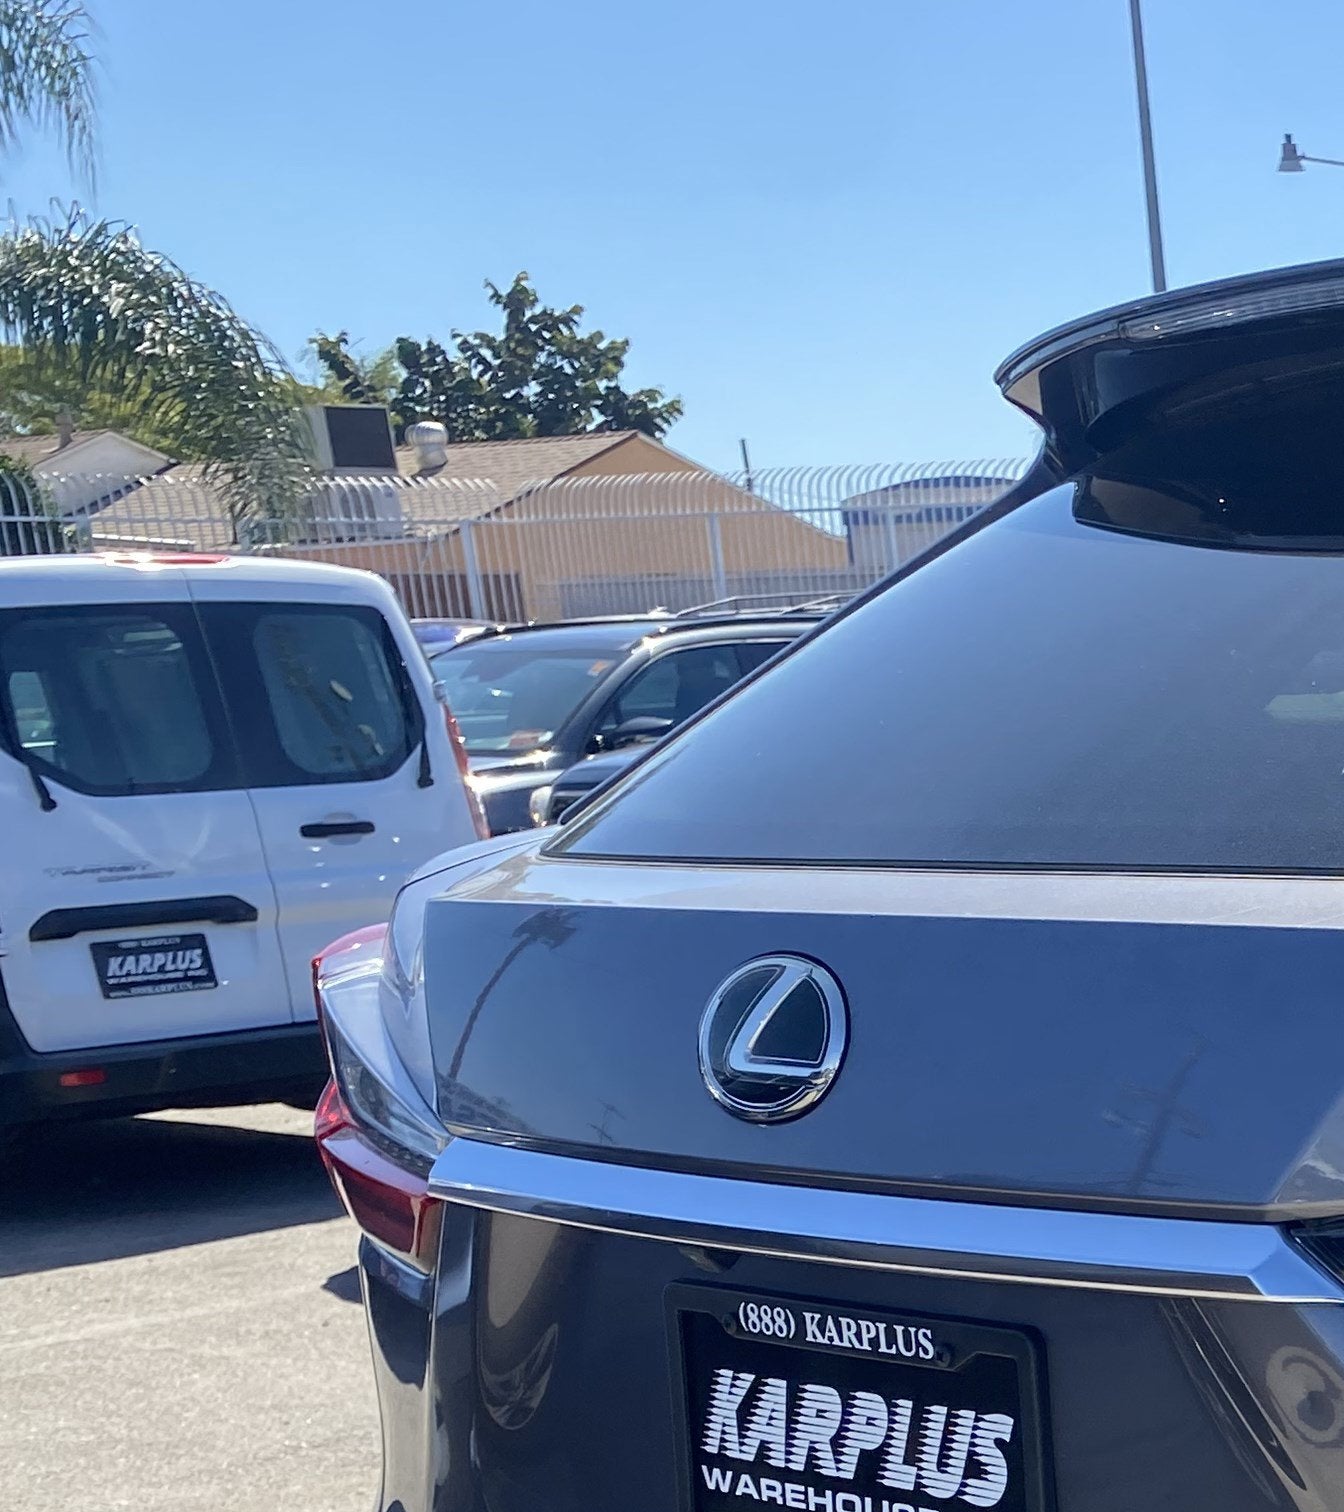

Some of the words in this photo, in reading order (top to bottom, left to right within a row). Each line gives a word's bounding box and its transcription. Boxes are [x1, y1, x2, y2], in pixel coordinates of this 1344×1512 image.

[107, 948, 203, 977] KARPLUS
[738, 1302, 796, 1339] (888)
[804, 1312, 935, 1360] KARPLUS
[700, 1367, 1015, 1508] KARPLUS
